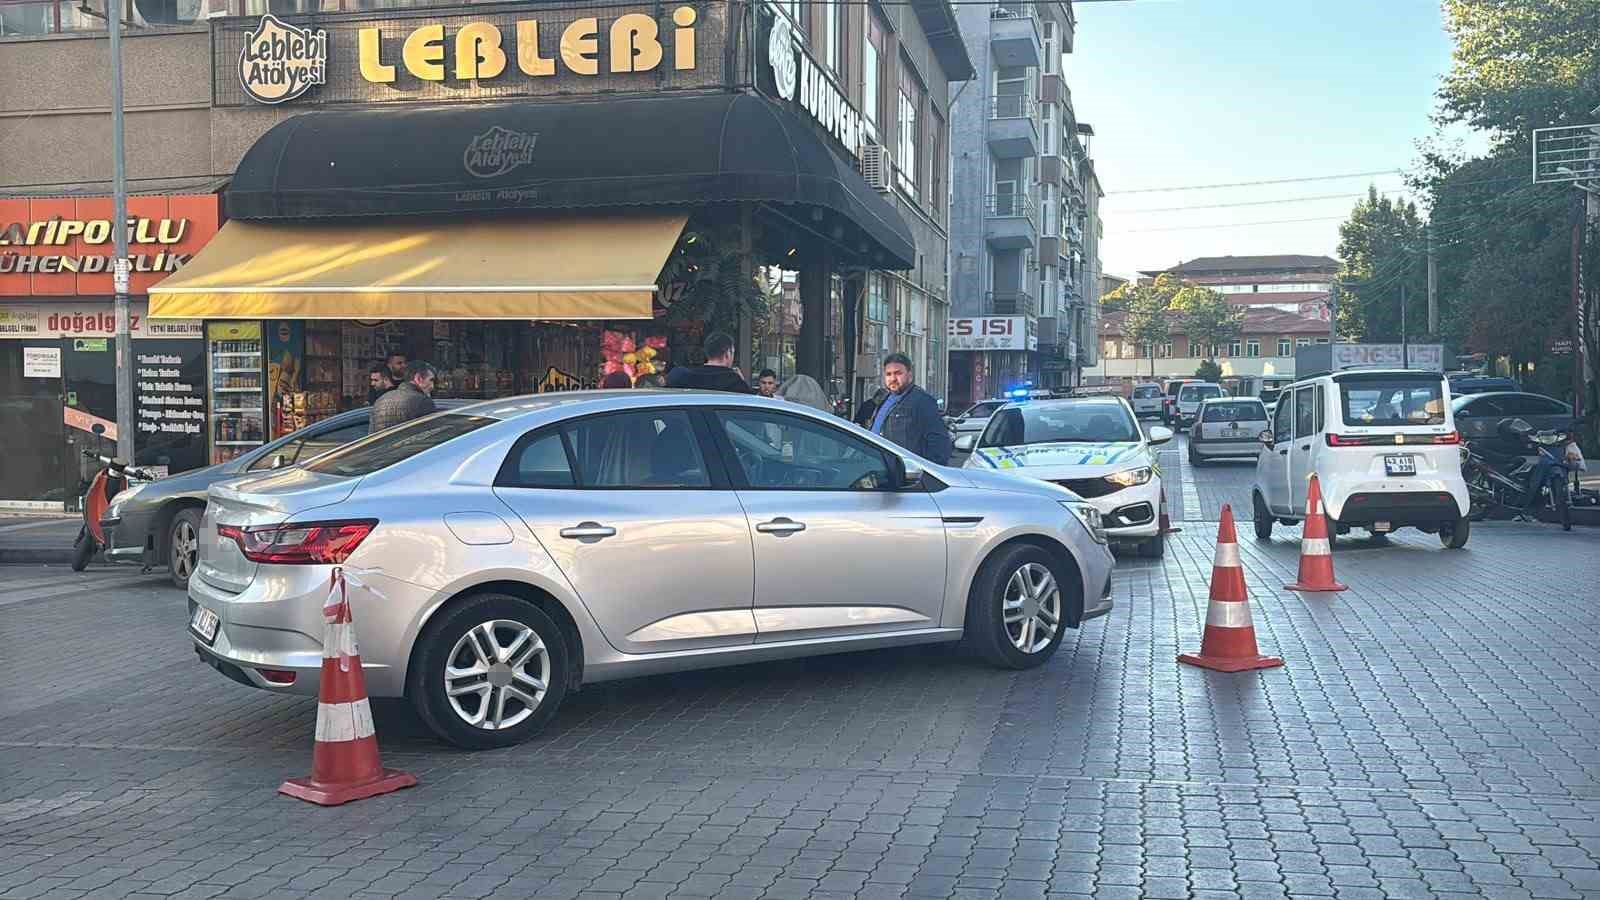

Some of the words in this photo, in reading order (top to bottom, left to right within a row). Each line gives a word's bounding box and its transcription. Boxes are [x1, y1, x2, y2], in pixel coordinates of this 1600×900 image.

[245, 30, 326, 61] Leblebi
[248, 60, 326, 95] Atölyesi
[48, 311, 140, 333] doğalgz
[982, 319, 1013, 336] ISI
